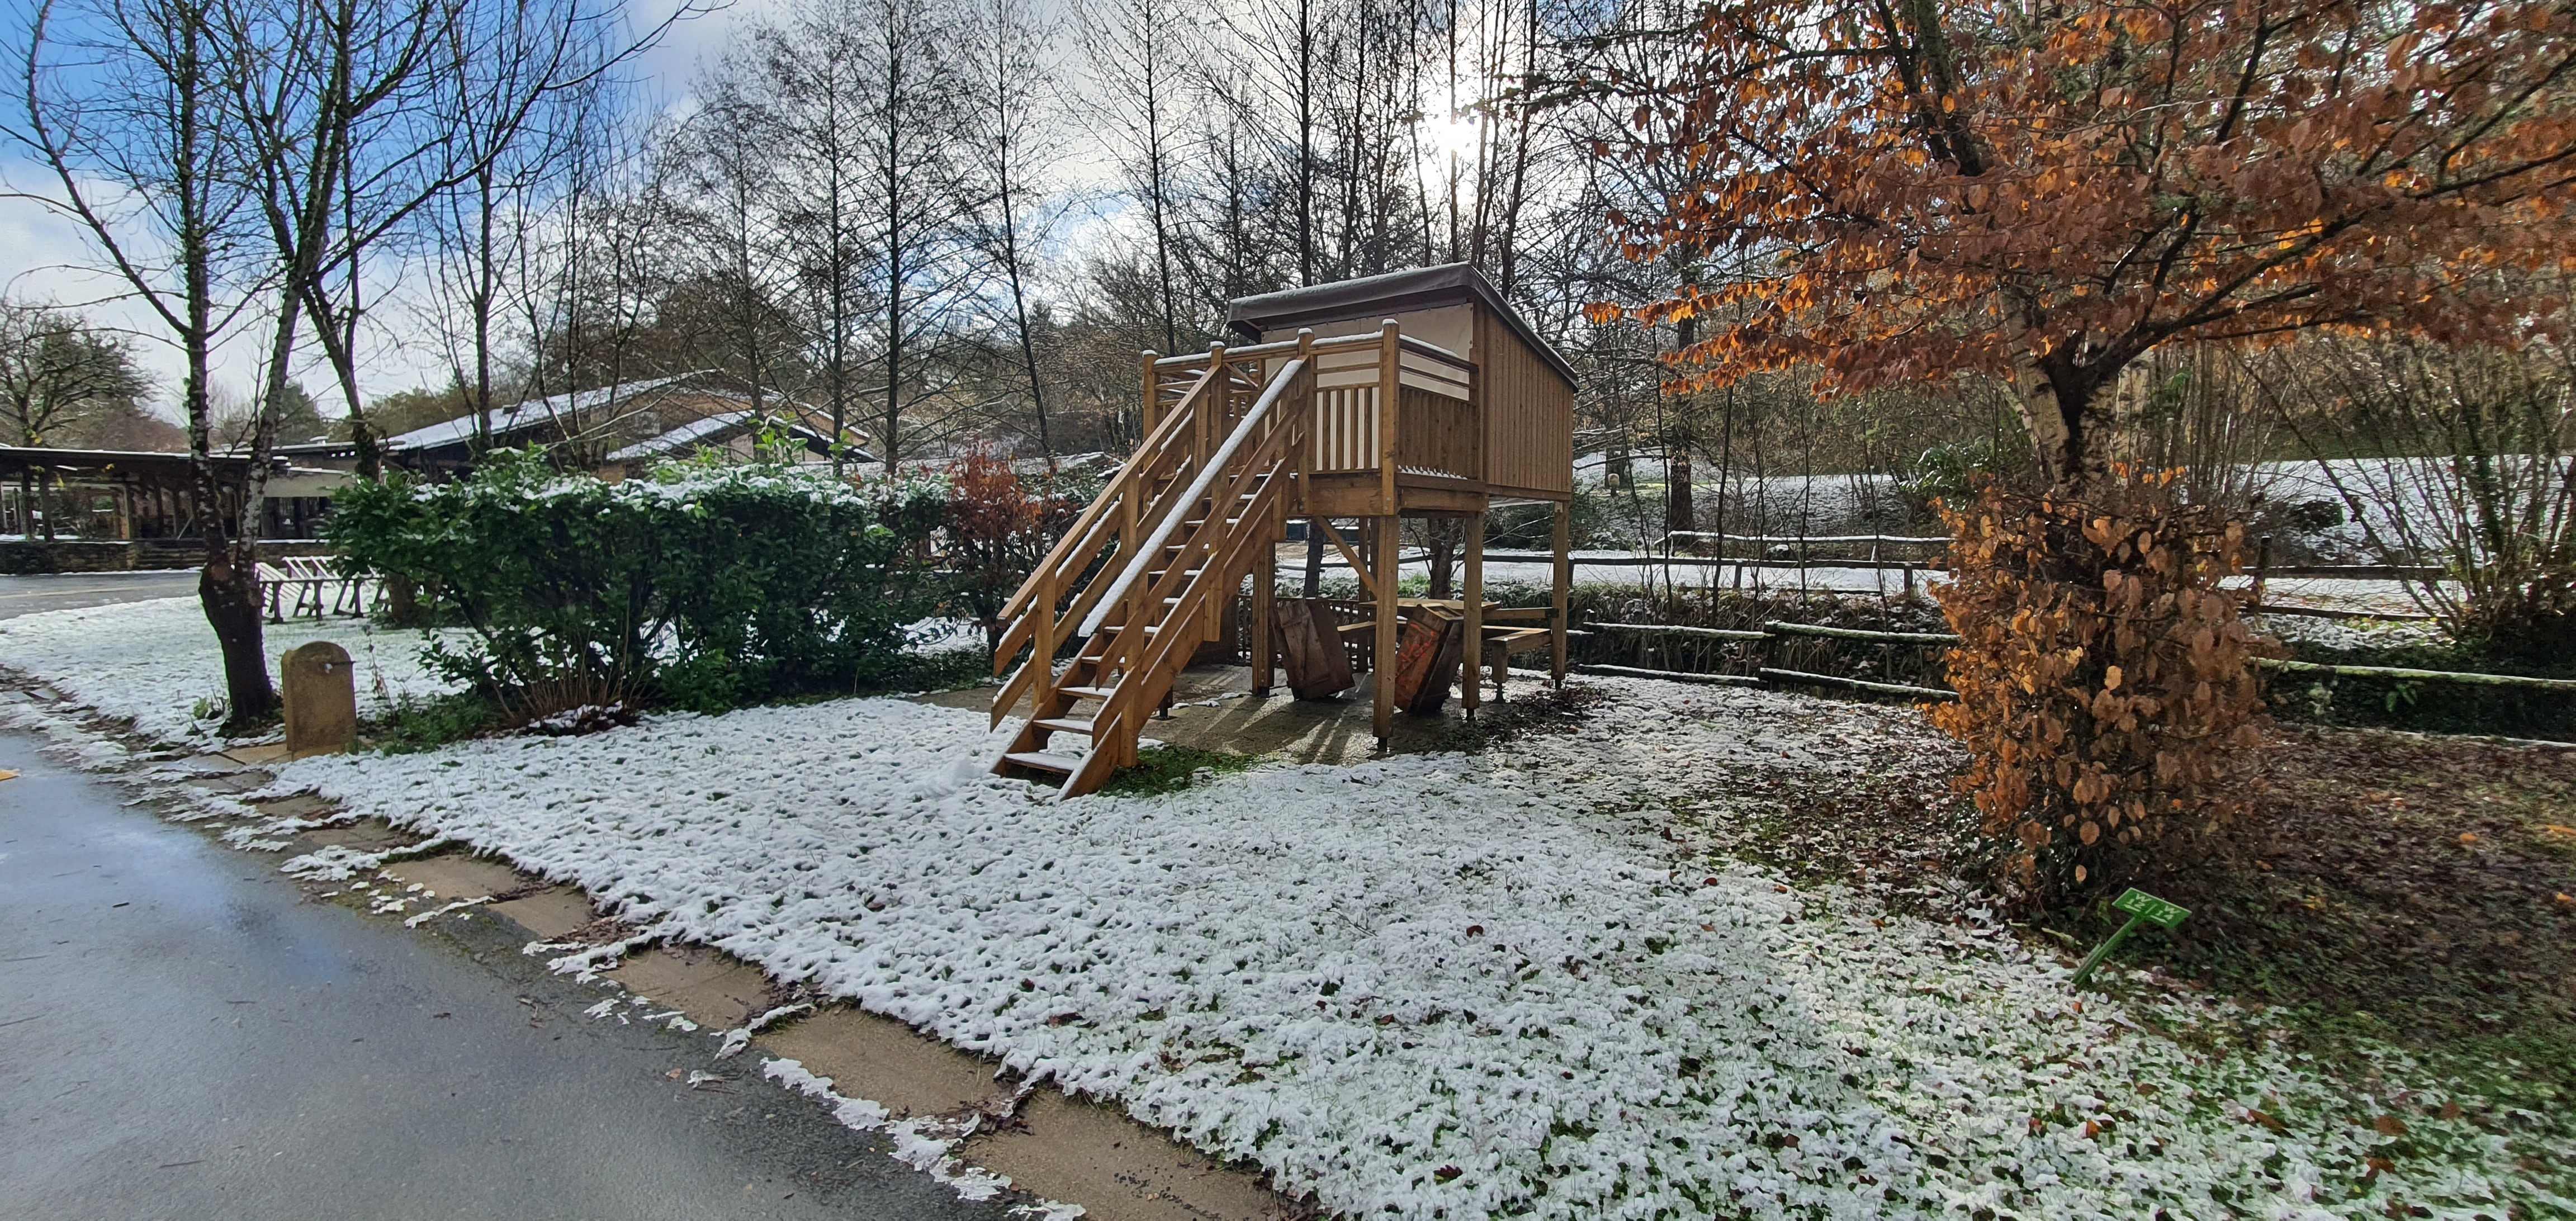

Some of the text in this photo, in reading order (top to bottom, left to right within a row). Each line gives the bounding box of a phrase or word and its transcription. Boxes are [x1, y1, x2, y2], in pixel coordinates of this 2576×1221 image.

[2135, 893, 2152, 902] W
[2127, 898, 2146, 909] 12
[2164, 905, 2181, 914] W
[2155, 910, 2174, 920] 14
